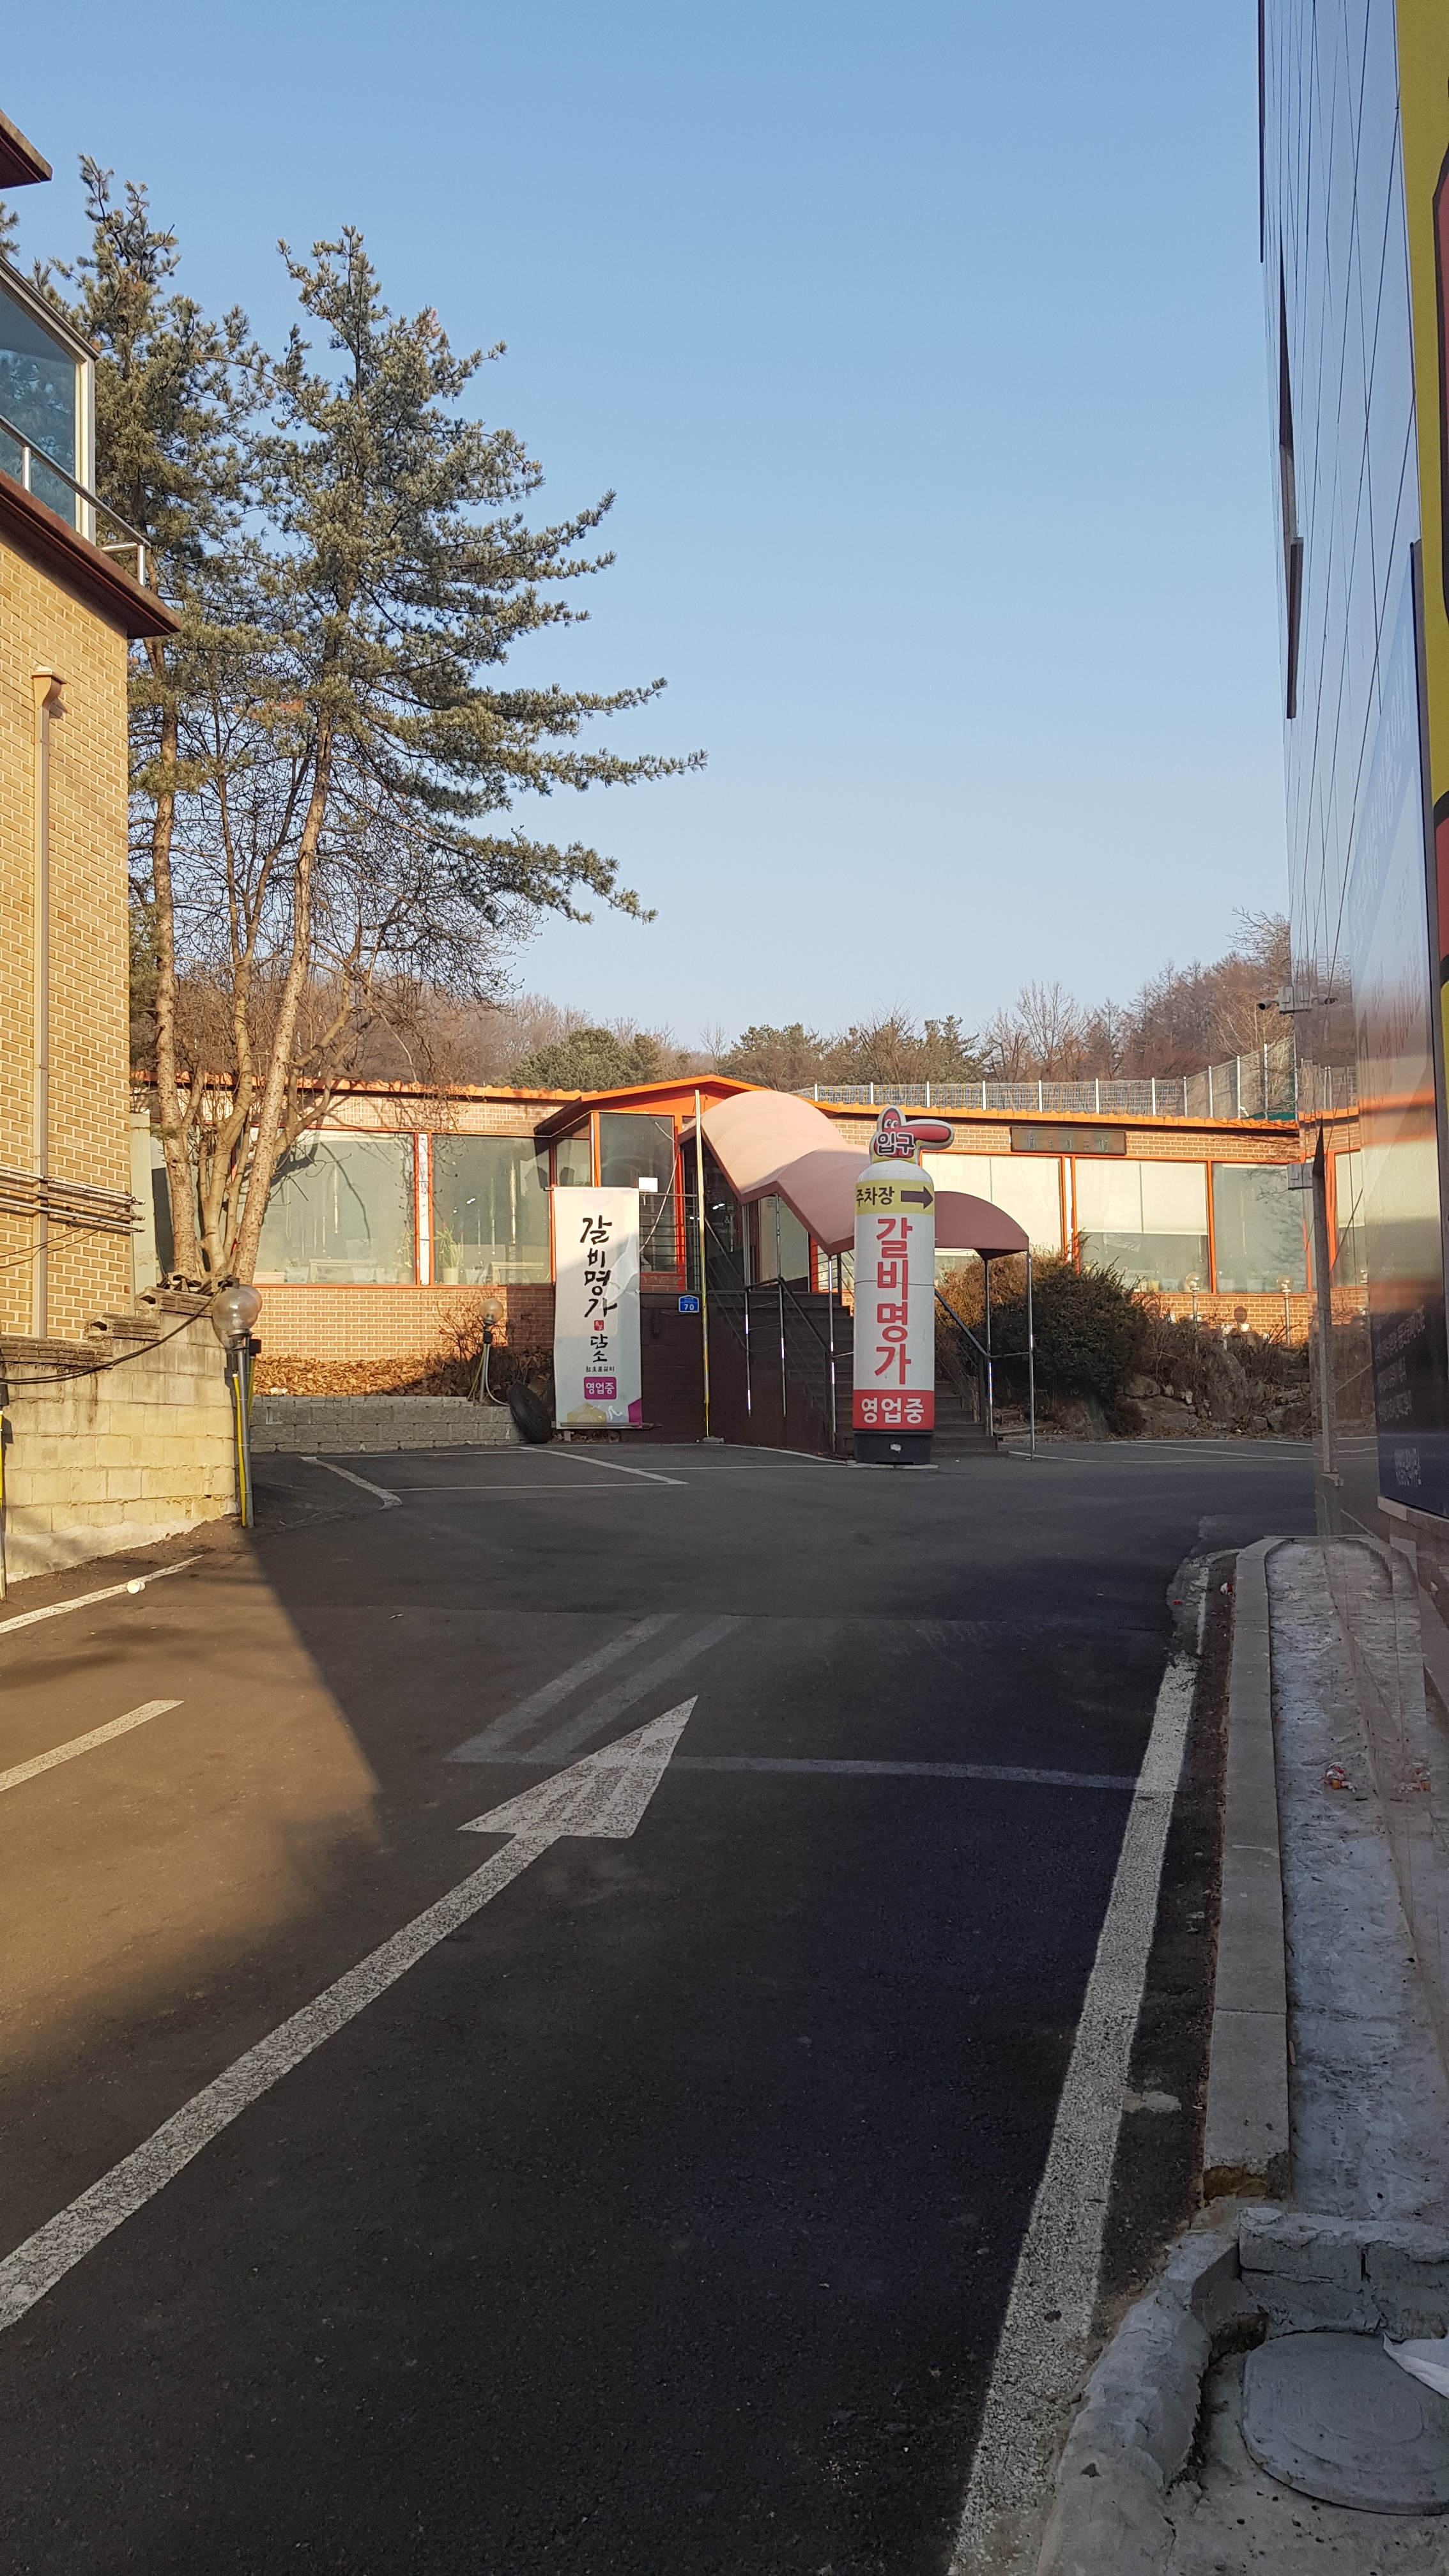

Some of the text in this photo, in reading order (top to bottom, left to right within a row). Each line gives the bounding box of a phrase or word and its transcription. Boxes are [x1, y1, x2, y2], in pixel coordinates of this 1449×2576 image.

[876, 1130, 915, 1155] 입구
[856, 1186, 894, 1207] 주차장
[580, 1215, 618, 1318] 갈비명가
[875, 1217, 913, 1386] 갈비명가
[590, 1333, 609, 1363] 담소
[585, 1382, 615, 1395] 영업중
[861, 1397, 924, 1424] 영업중
